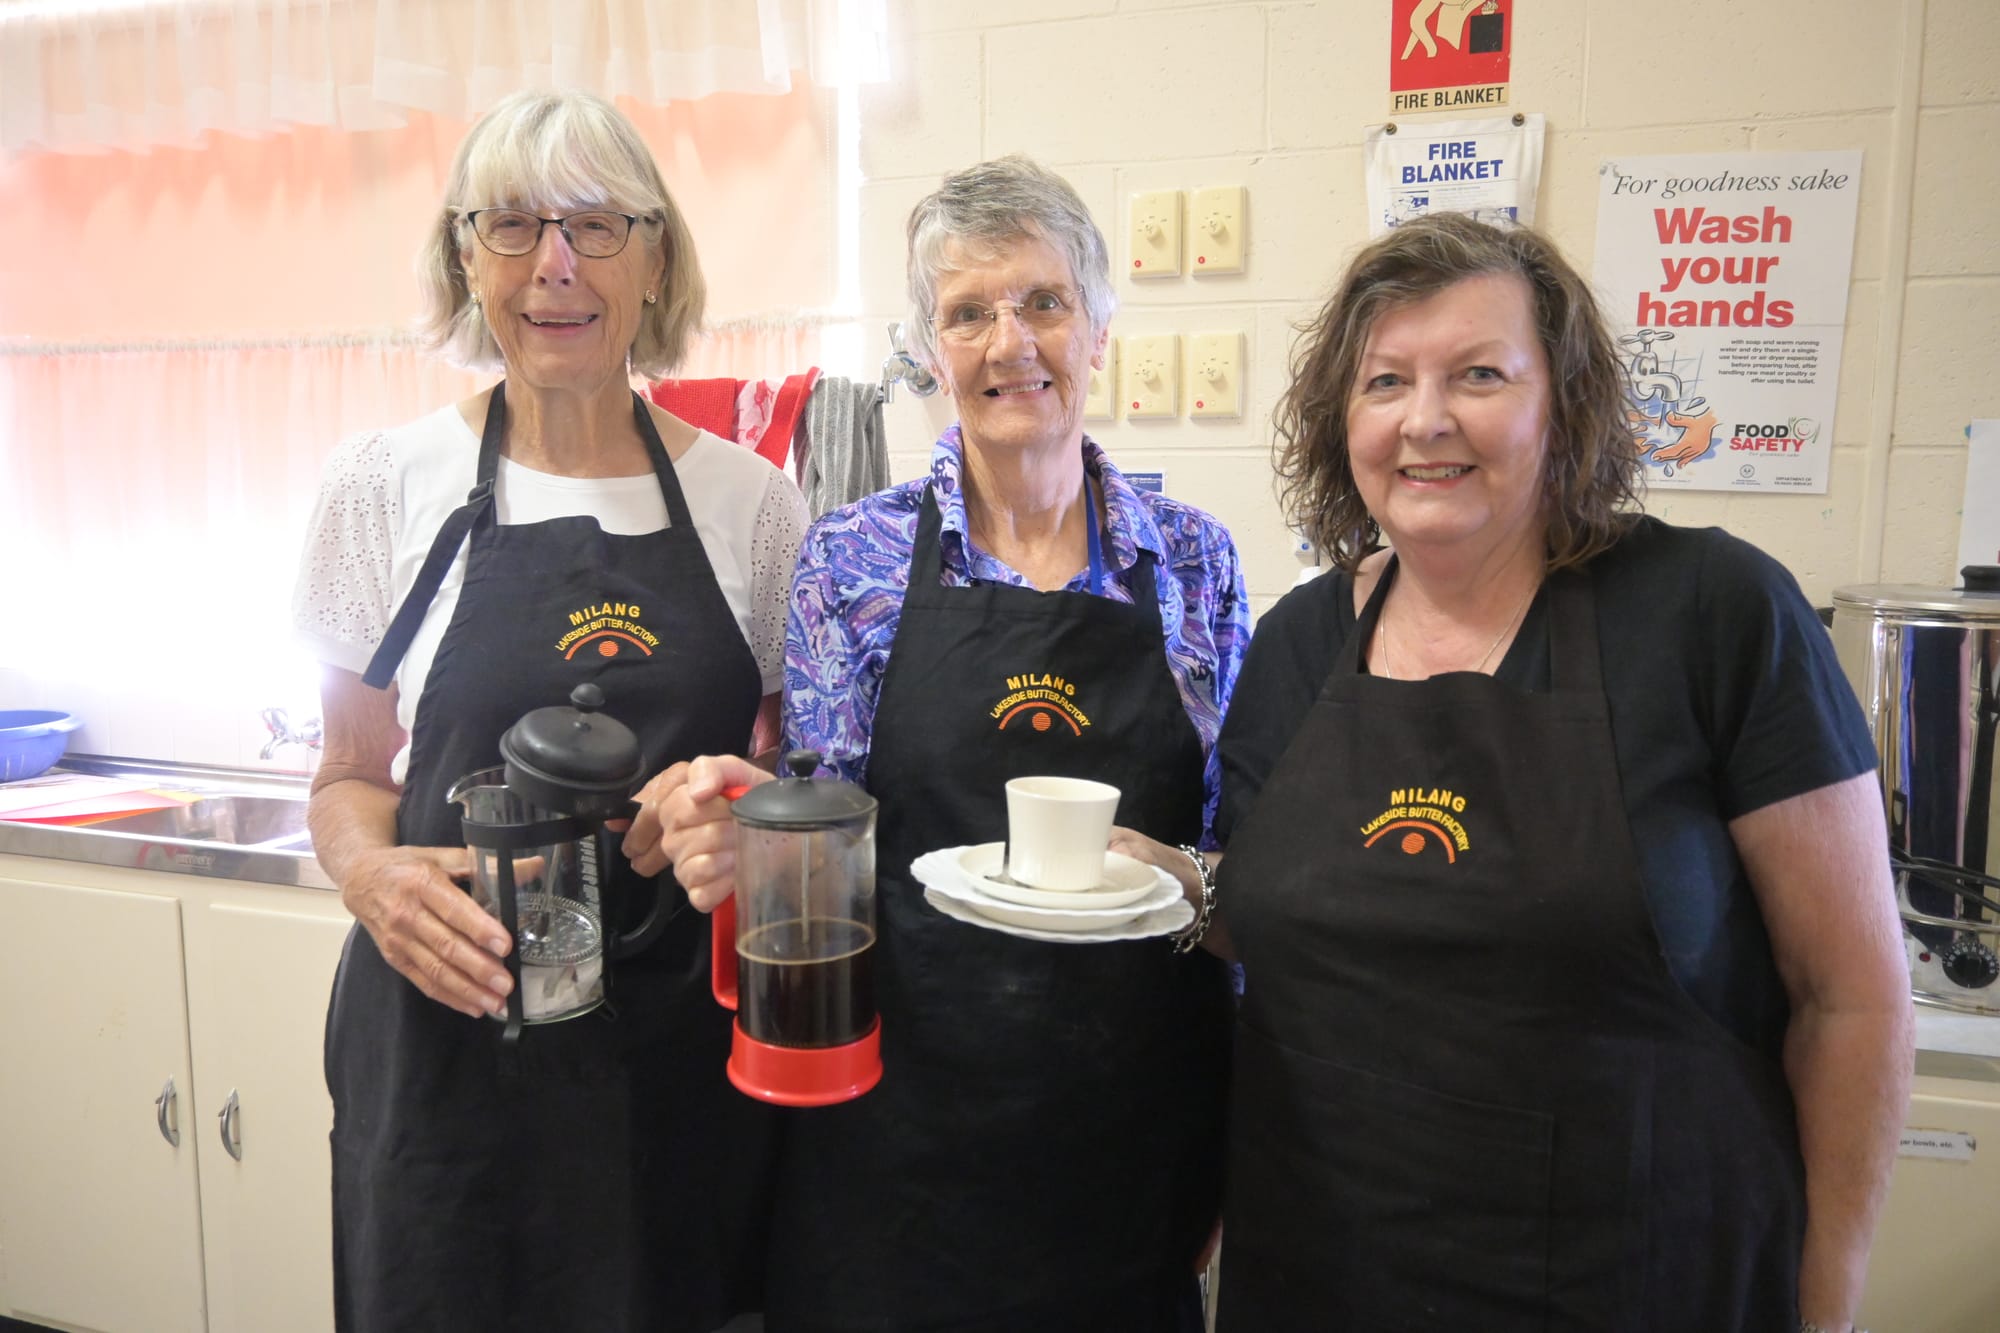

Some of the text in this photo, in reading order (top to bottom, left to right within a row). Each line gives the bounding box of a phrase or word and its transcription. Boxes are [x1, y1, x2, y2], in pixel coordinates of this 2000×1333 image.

[1395, 87, 1504, 110] FIRE BLANKET
[1429, 141, 1476, 160] FIRE
[1402, 160, 1503, 184] BLANKET
[1612, 169, 1848, 199] For goodness sake
[1653, 206, 1792, 244] Wash
[1660, 256, 1779, 292] your
[1637, 291, 1794, 328] hands
[1734, 424, 1788, 438] FOOD
[1729, 438, 1805, 452] SAFETY
[568, 602, 641, 626] MILANG
[555, 618, 659, 652] LAKESIDE BUTTER FACTORY
[1006, 673, 1076, 696] MILANG
[990, 689, 1091, 727] LAKESIDE BUTTER FACTORY
[1391, 788, 1466, 813] MILANG
[1360, 807, 1470, 851] LAKESIDE BUTTER FACTORY
